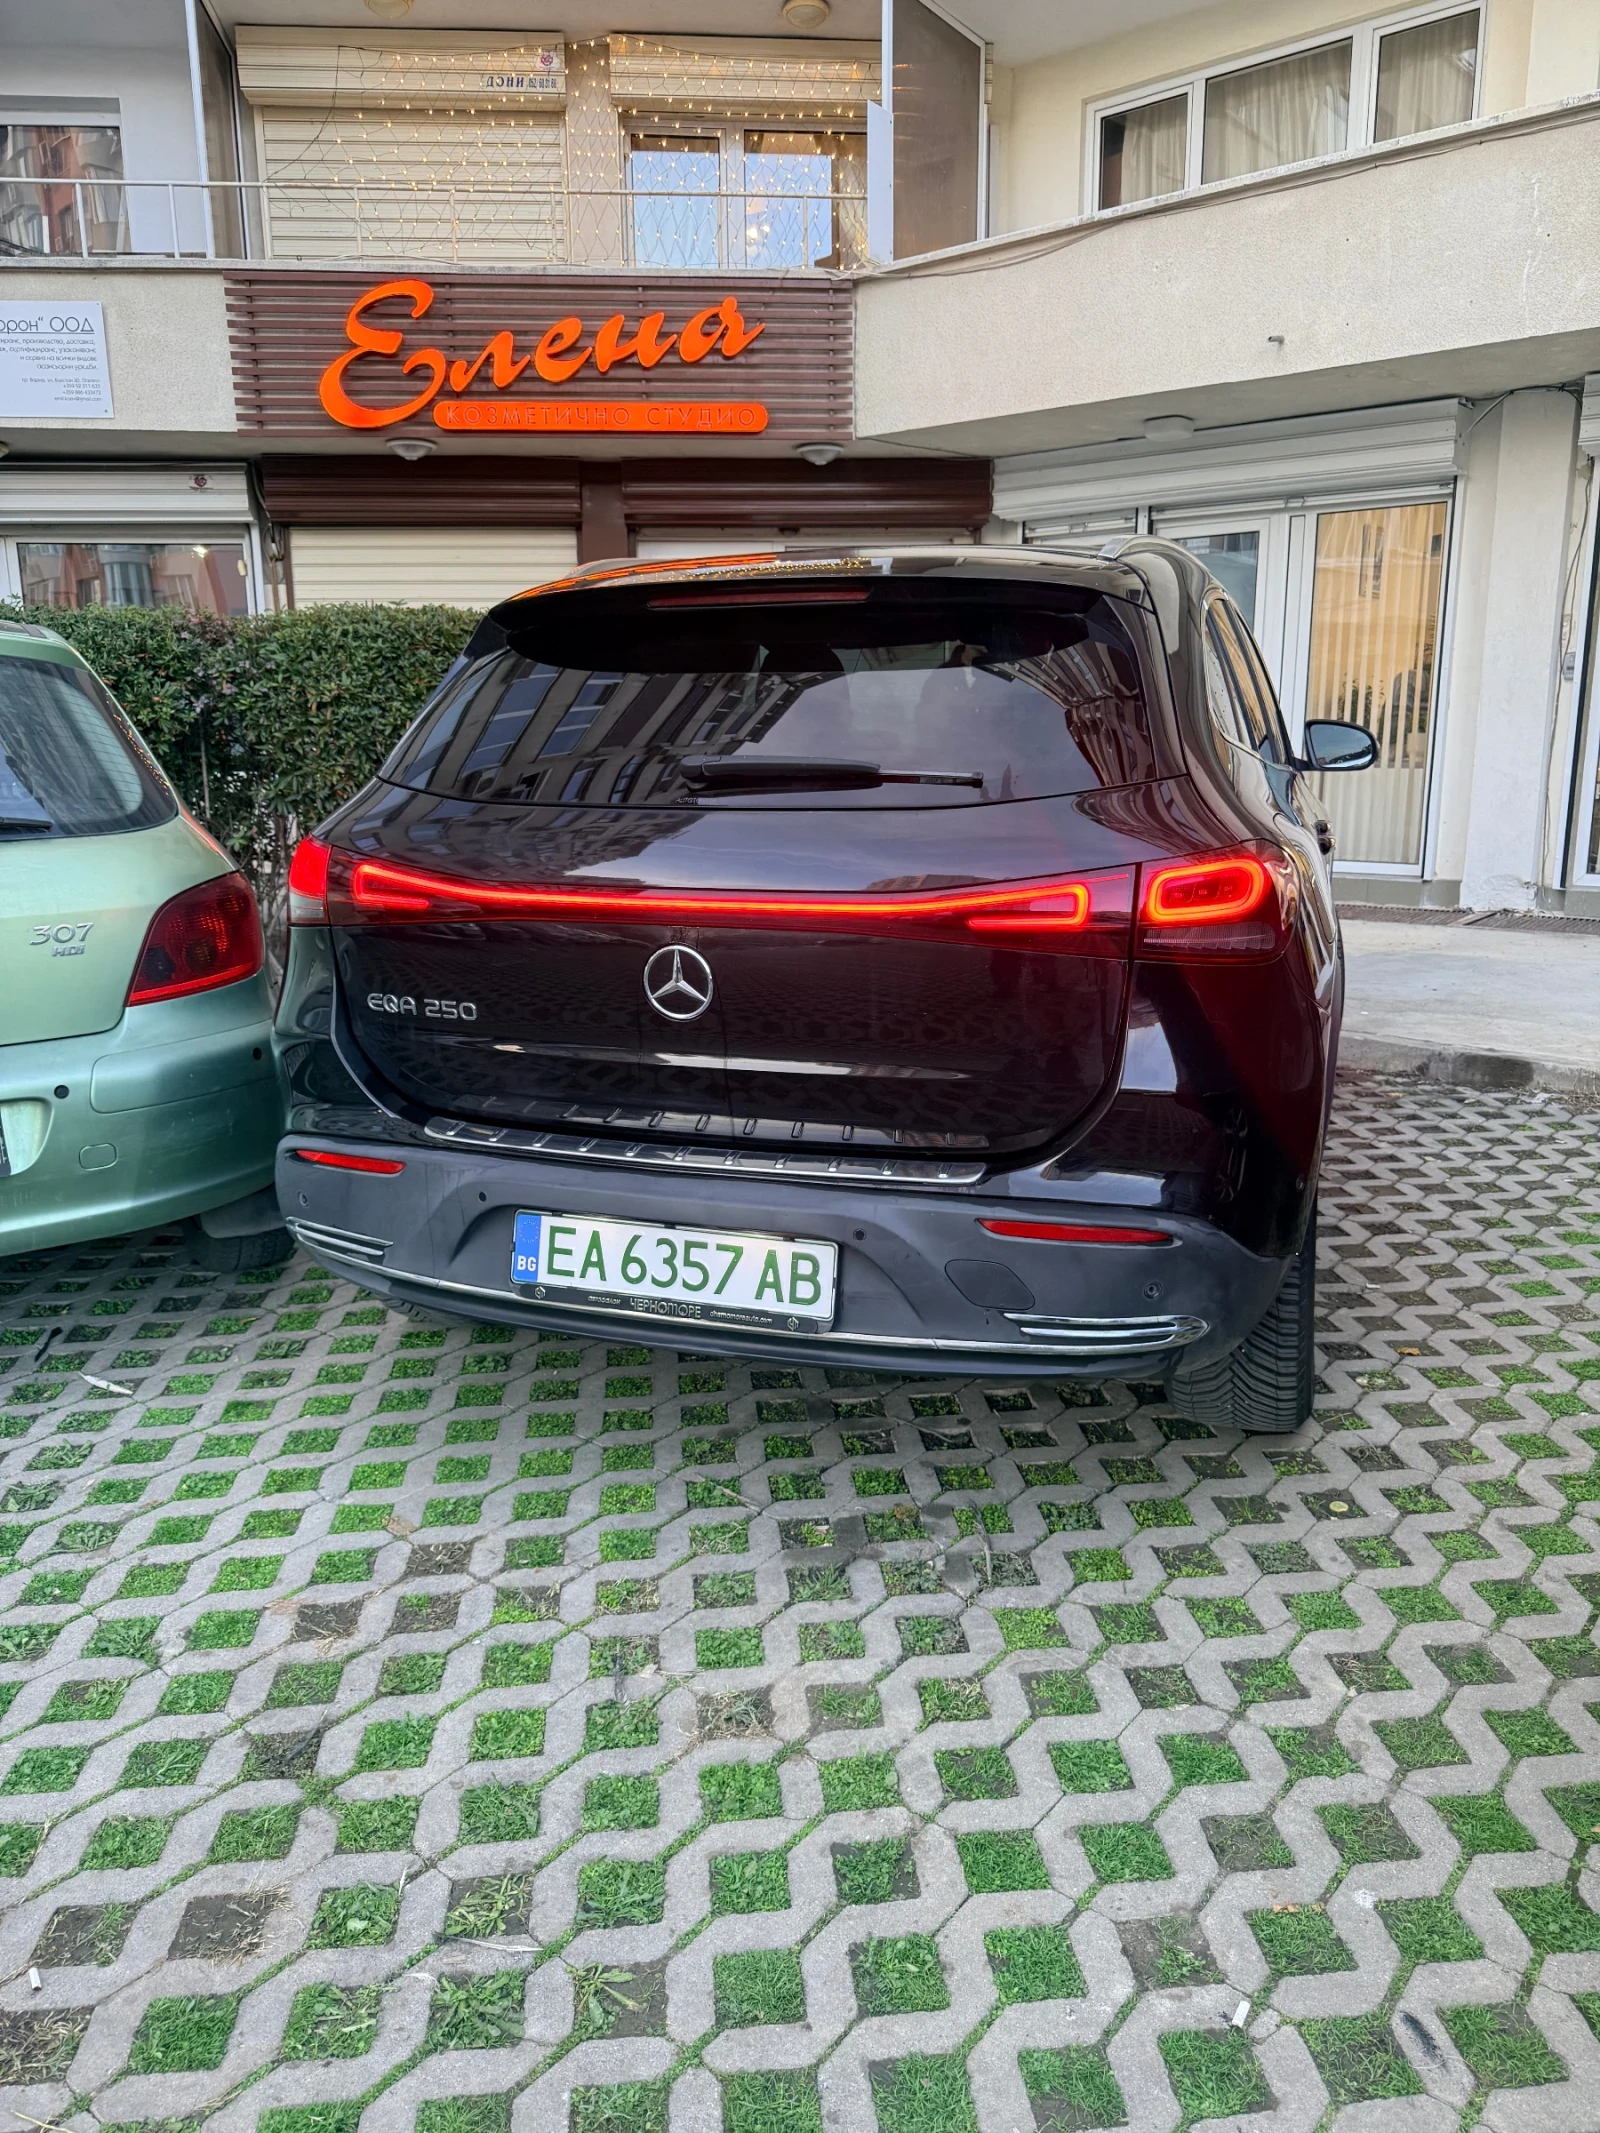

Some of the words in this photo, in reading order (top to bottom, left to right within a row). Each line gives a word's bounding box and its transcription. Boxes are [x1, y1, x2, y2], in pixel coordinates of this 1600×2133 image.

[49, 316, 95, 332] ООД
[319, 279, 766, 428] Елена
[446, 405, 631, 425] КОЗМЕТИЧНО
[646, 406, 757, 427] СТУДИО
[29, 921, 94, 946] 307
[366, 992, 418, 1015] EQA
[423, 998, 478, 1021] 250
[516, 1255, 537, 1272] BG
[547, 1225, 607, 1282] EA
[620, 1234, 744, 1295] 6357
[754, 1249, 821, 1306] AB
[629, 1296, 702, 1319] ЧЕРНОМОРЕ
